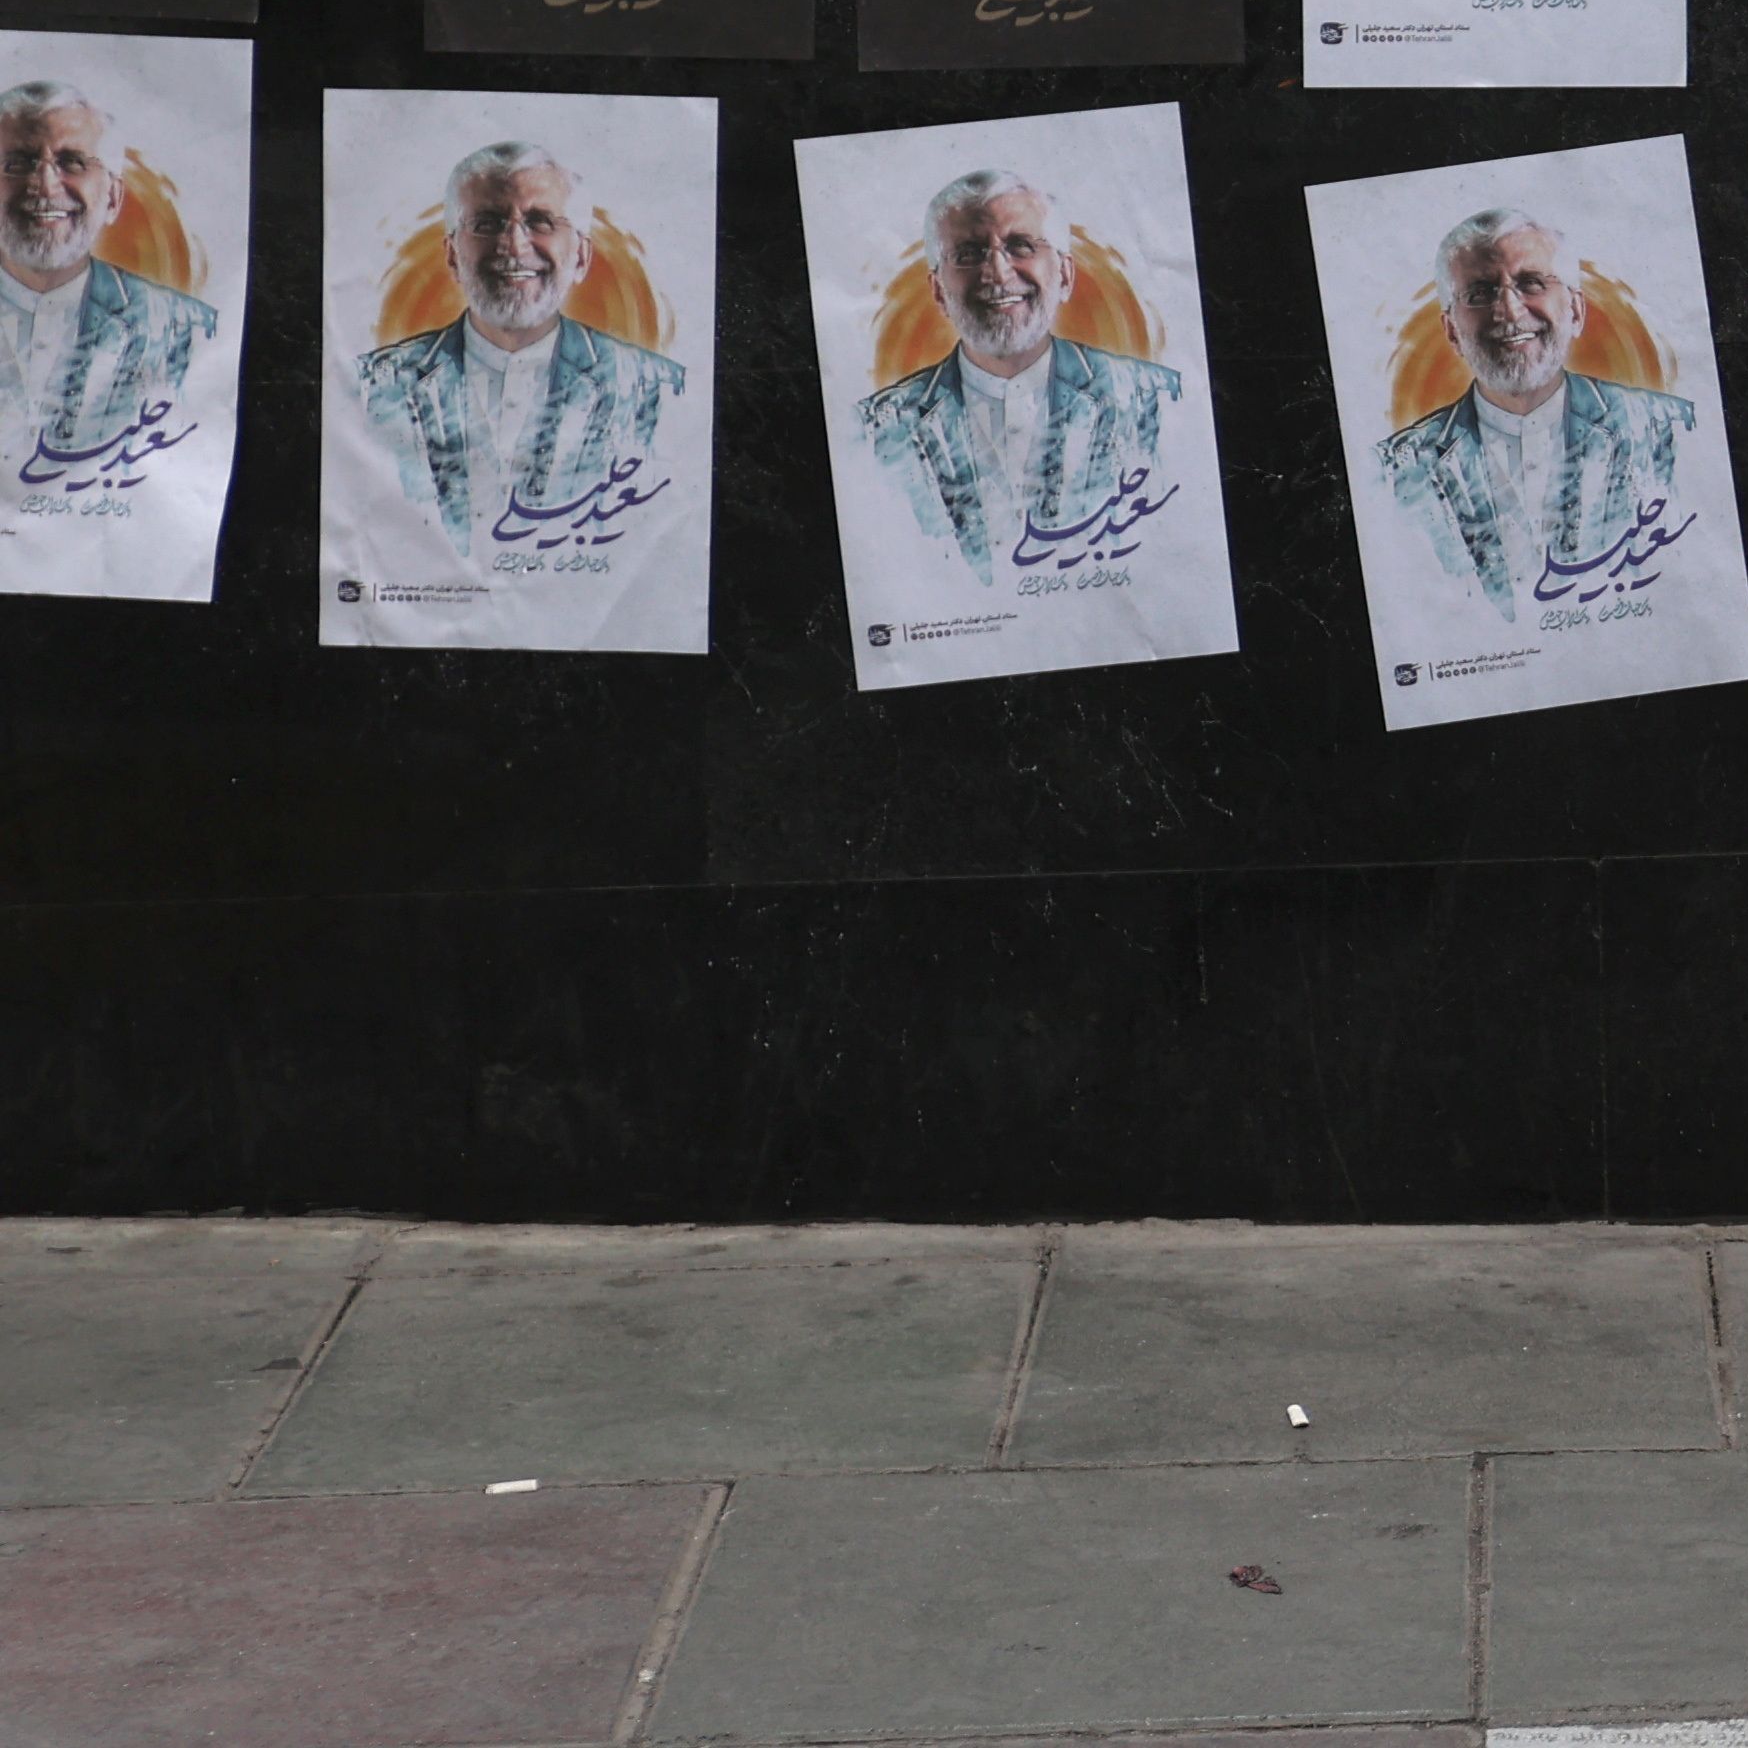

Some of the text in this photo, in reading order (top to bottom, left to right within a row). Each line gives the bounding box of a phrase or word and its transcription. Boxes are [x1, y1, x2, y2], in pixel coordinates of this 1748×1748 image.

[18, 397, 202, 492] سعید جلیلی
[491, 454, 671, 549] سعید جلیلی
[1011, 465, 1180, 570] سعید جلیلی
[1532, 496, 1697, 603] سعید جلیلی
